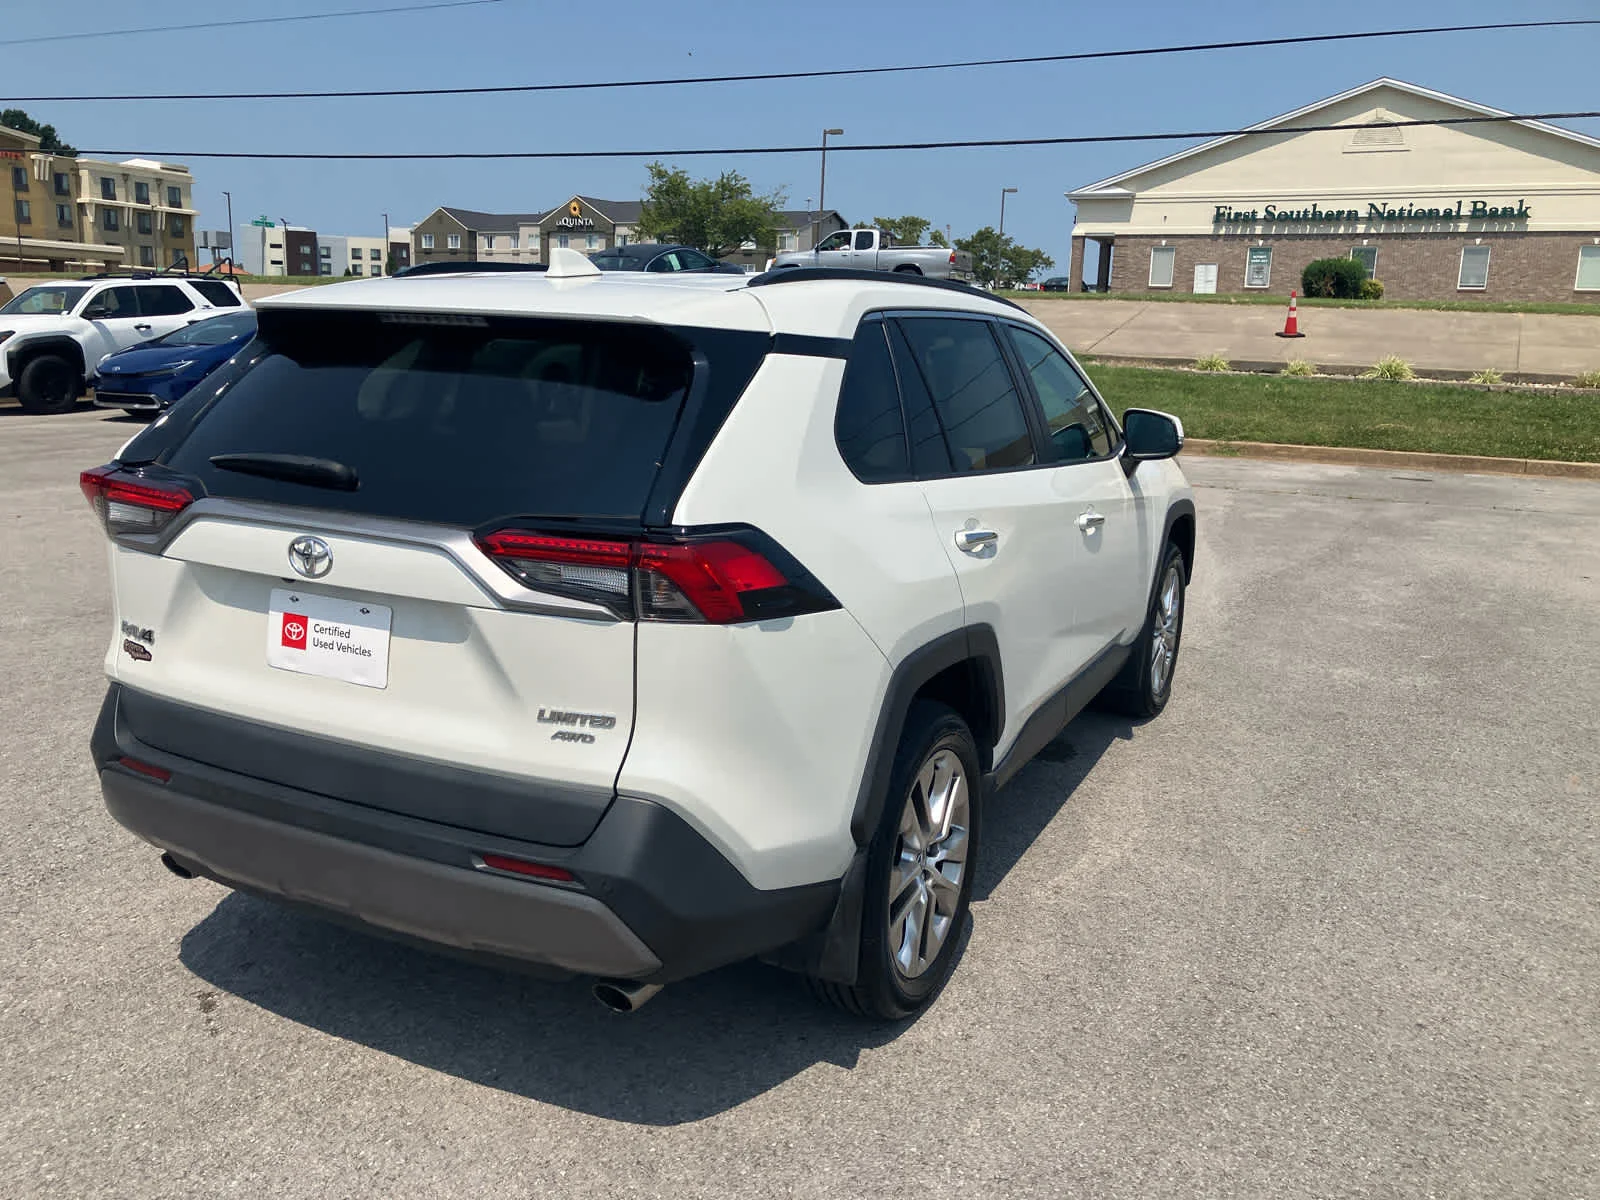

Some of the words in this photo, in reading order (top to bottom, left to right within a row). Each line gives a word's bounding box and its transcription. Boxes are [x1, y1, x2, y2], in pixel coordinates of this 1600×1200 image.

[1213, 205, 1258, 224] First
[1264, 203, 1360, 222] Southern
[1367, 200, 1462, 221] National
[1469, 199, 1532, 219] Bank
[562, 216, 594, 228] QUINTA
[313, 623, 351, 639] Certified
[312, 637, 335, 650] Used
[336, 641, 372, 657] Vehicles
[537, 708, 617, 730] LIMITED
[550, 731, 596, 744] AWD
